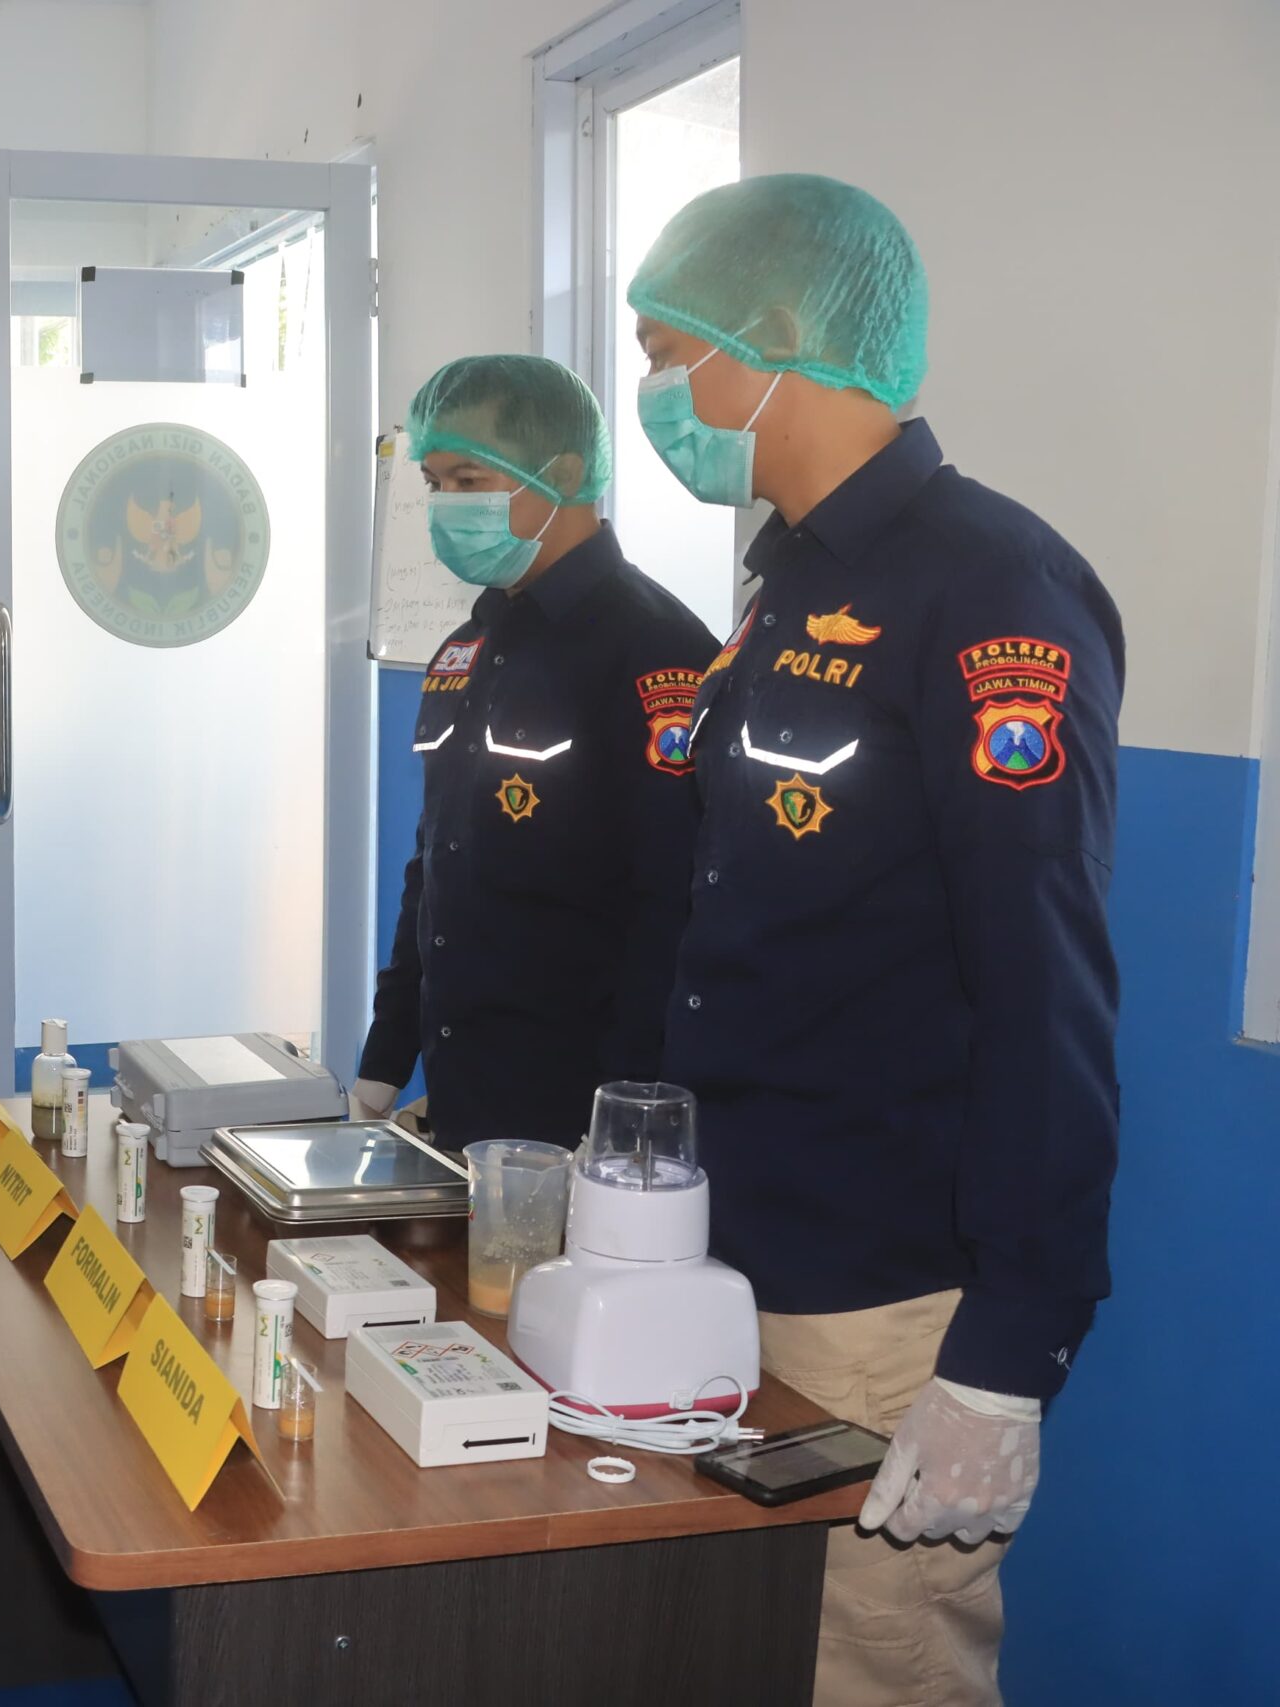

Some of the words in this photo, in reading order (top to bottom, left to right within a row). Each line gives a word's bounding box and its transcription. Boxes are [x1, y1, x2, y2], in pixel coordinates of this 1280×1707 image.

[971, 642, 1059, 662] POLRES
[773, 649, 863, 688] POLRI
[975, 655, 1055, 670] PROBOLINGGO
[645, 671, 704, 687] POLRES
[976, 678, 1013, 693] JAWA
[1016, 678, 1056, 694] TIMUR
[649, 697, 674, 708] JAWA
[70, 1236, 121, 1315] FORMALIN
[150, 1338, 205, 1426] SIANIDA
